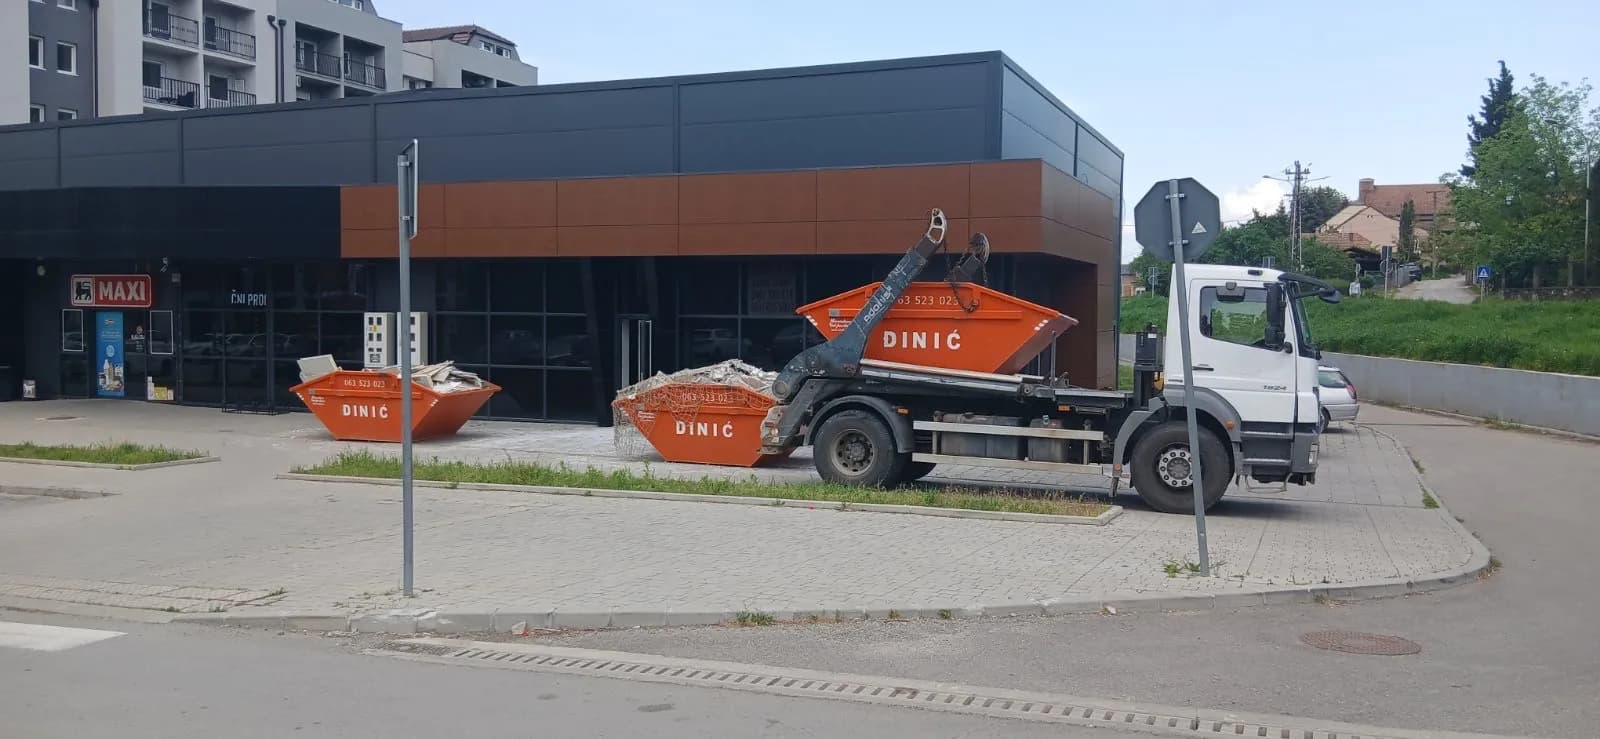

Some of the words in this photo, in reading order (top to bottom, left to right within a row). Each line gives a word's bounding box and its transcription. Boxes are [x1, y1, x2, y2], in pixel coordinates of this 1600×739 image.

[99, 281, 146, 301] MAXI
[897, 295, 910, 305] 63
[915, 295, 934, 305] 523
